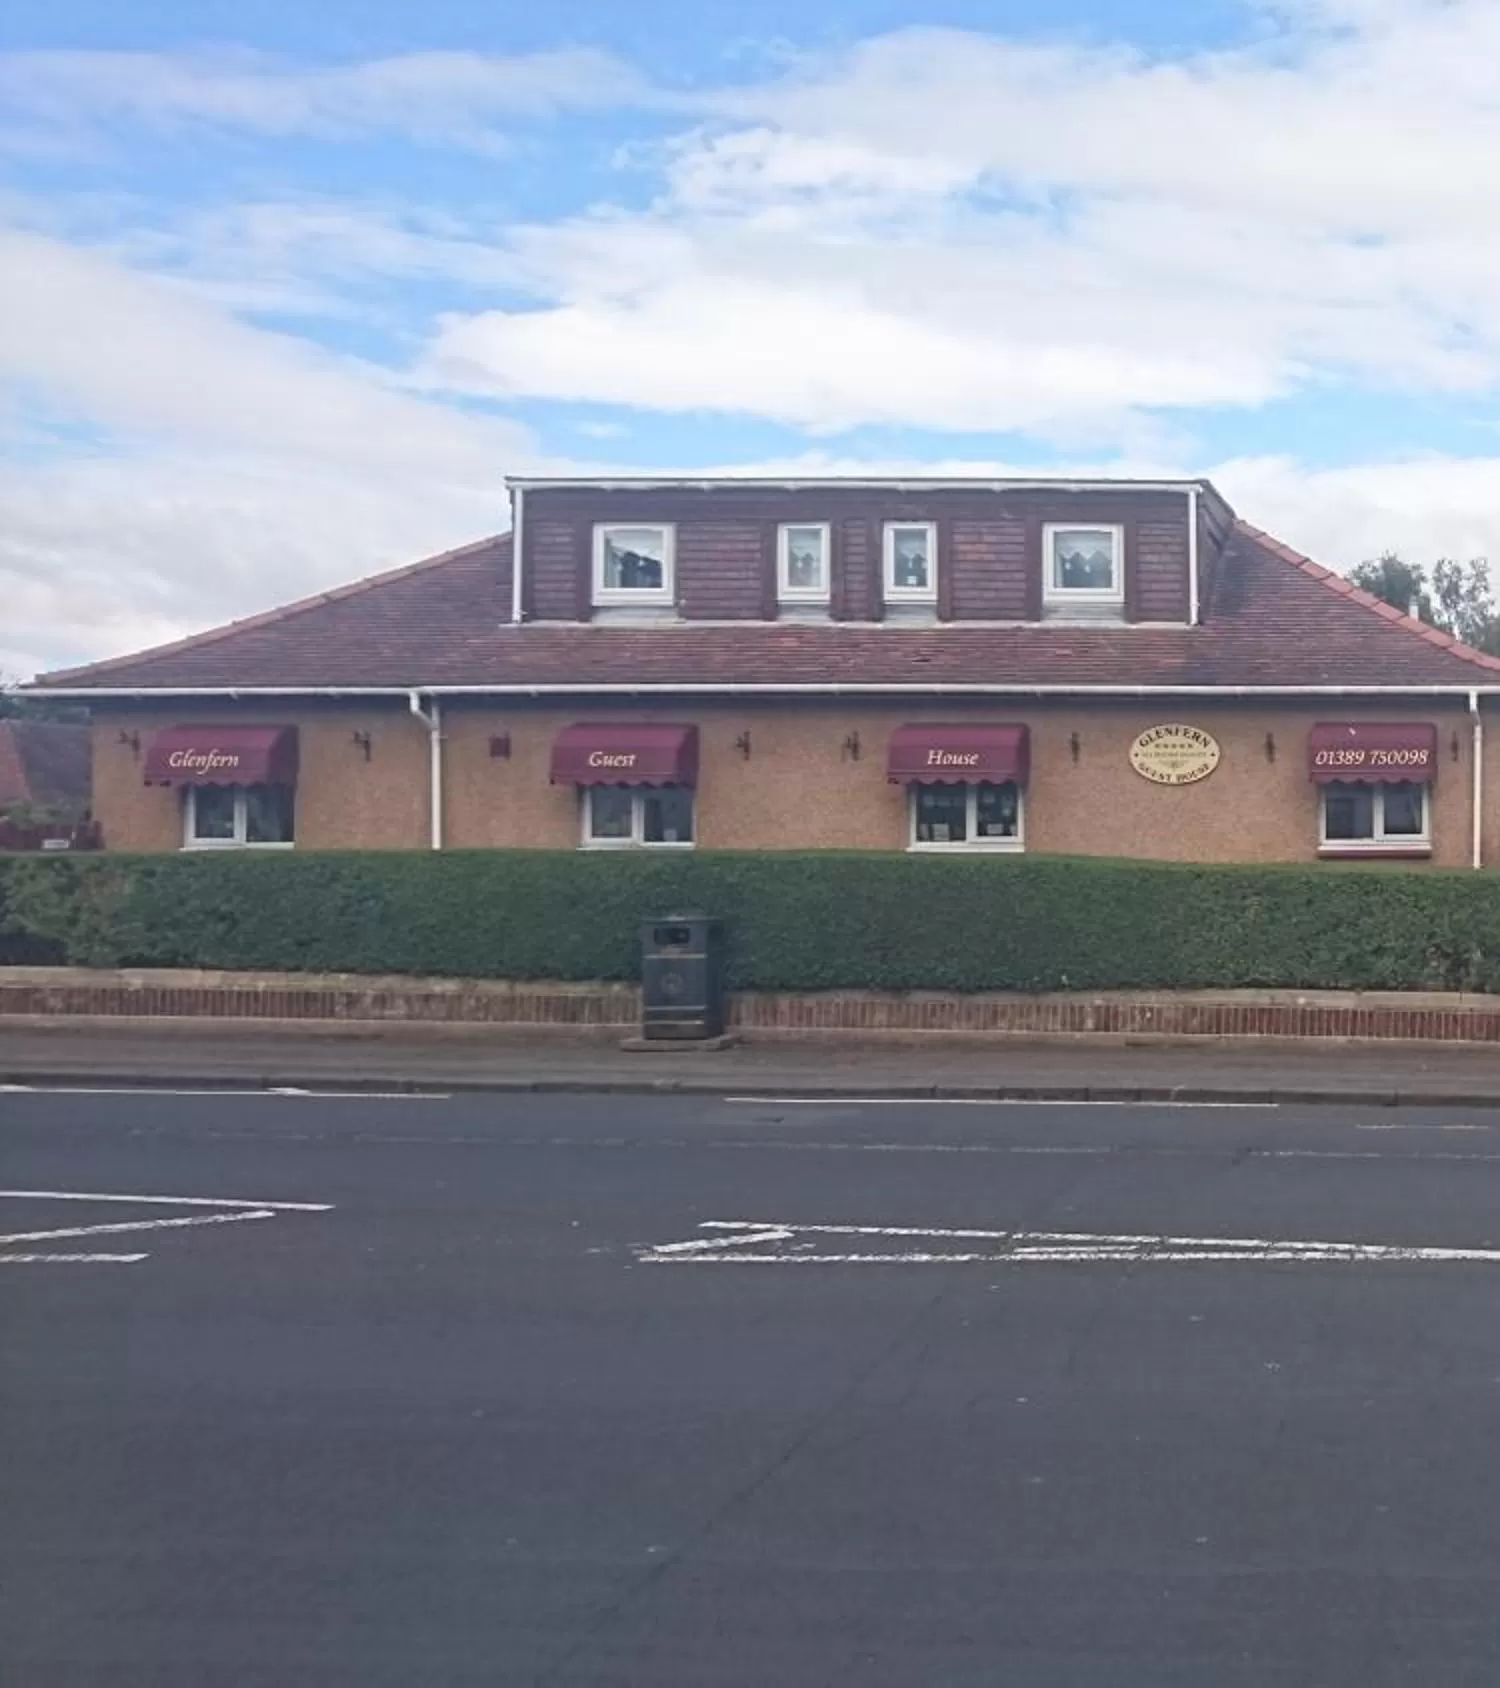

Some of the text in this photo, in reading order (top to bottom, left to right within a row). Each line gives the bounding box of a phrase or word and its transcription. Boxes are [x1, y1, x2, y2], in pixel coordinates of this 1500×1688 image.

[1139, 727, 1210, 748] GLENFERN
[168, 748, 240, 775] Glenfern
[588, 751, 636, 767] Guest
[927, 749, 979, 765] House
[1315, 749, 1429, 765] 01389 750098
